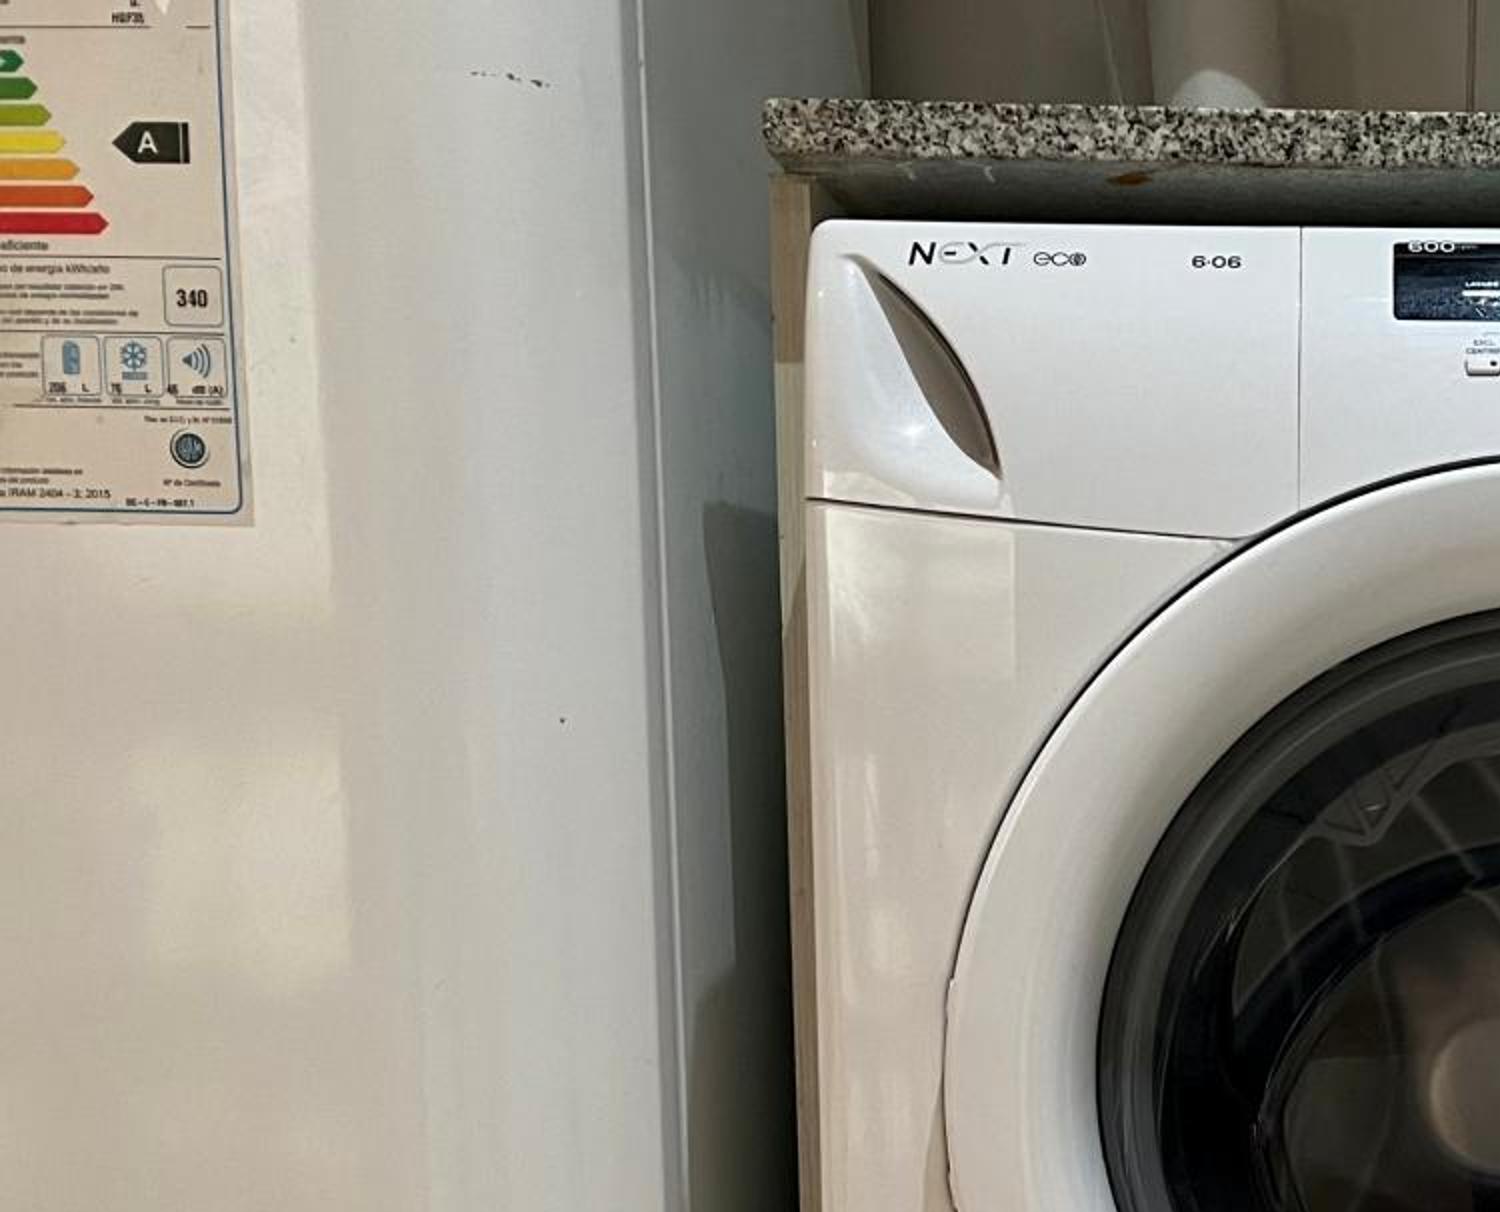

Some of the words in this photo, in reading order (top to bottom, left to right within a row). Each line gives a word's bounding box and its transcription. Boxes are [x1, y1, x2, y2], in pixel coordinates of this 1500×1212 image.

[138, 131, 158, 153] A
[1408, 240, 1455, 253] 600
[176, 289, 208, 308] 340
